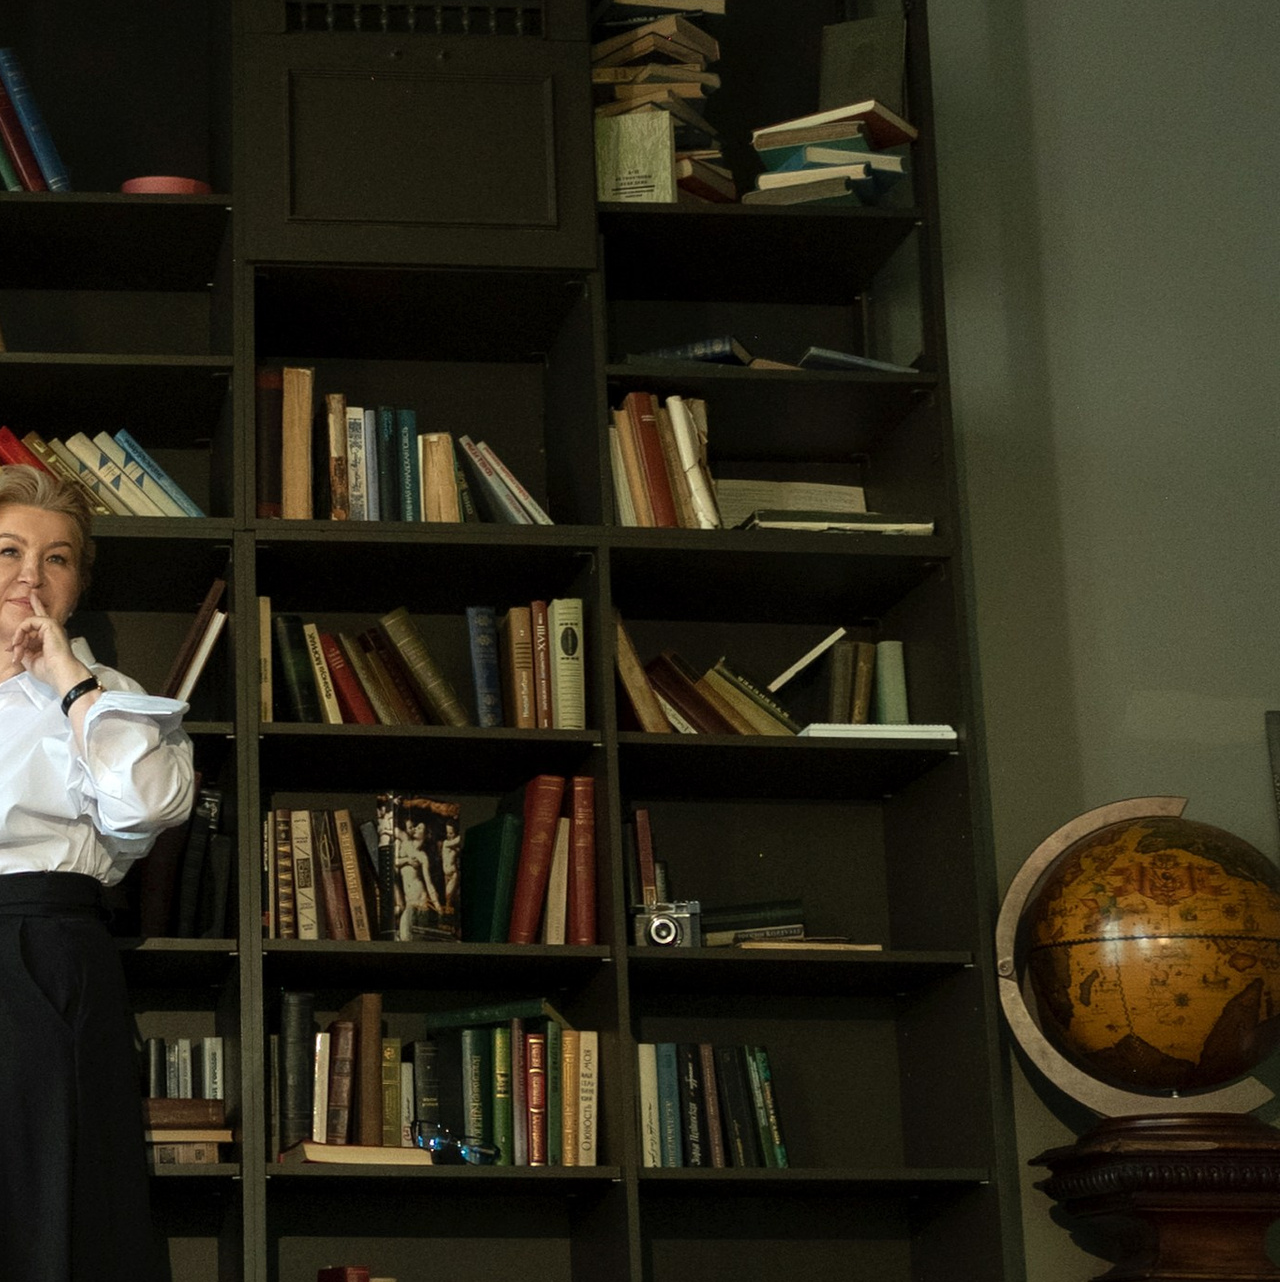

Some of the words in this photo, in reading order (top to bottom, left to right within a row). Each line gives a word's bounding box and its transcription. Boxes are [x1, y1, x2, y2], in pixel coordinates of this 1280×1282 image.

[305, 632, 324, 666] МОРИАК
[537, 625, 546, 650] XVIII
[582, 1049, 591, 1070] МОЯ
